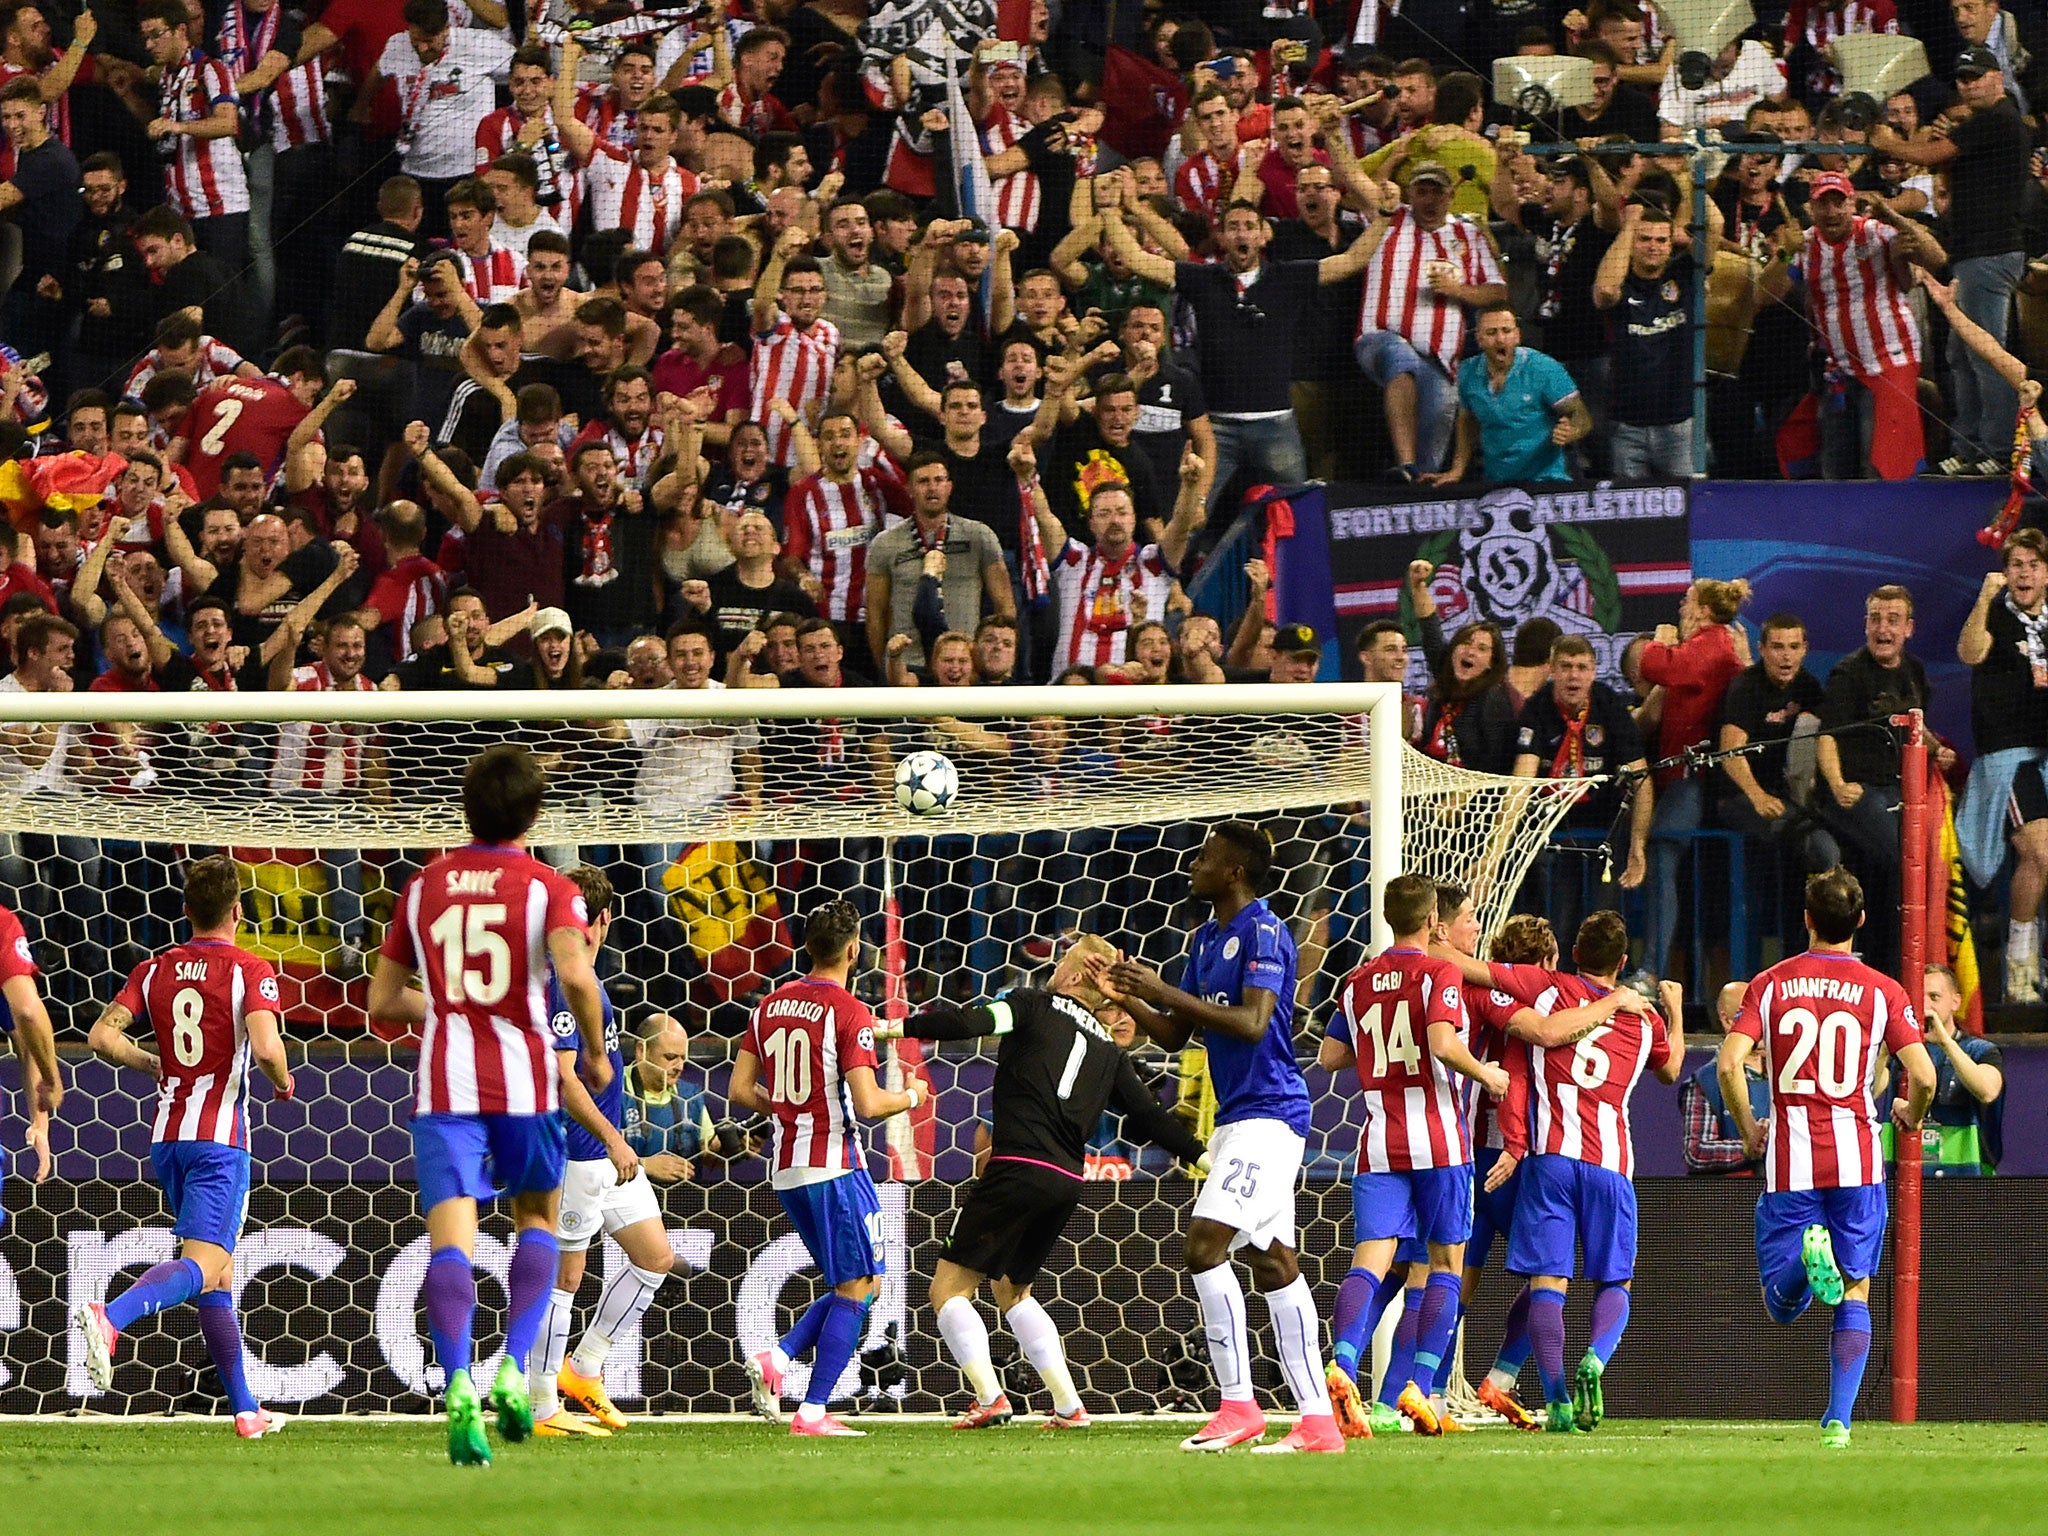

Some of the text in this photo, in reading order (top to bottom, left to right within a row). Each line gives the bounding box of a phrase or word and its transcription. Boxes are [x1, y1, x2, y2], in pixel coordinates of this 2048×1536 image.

[201, 399, 243, 455] 2
[1331, 480, 1686, 539] FORTUNA ATLÉTICO
[175, 959, 208, 981] SAÚL
[430, 904, 511, 1006] 15
[1372, 971, 1403, 992] GABI
[766, 998, 824, 1023] CARRASCO
[1781, 977, 1864, 1006] JUANFRAN
[172, 987, 204, 1067] 8
[1359, 1000, 1421, 1078] 14
[1571, 1025, 1612, 1089] 6
[1778, 1007, 1862, 1099] 20
[763, 1027, 812, 1105] 10
[1057, 1030, 1087, 1100] 1
[1221, 1158, 1261, 1198] 25
[864, 1211, 886, 1244] 10
[0, 1182, 910, 1402] rcard
